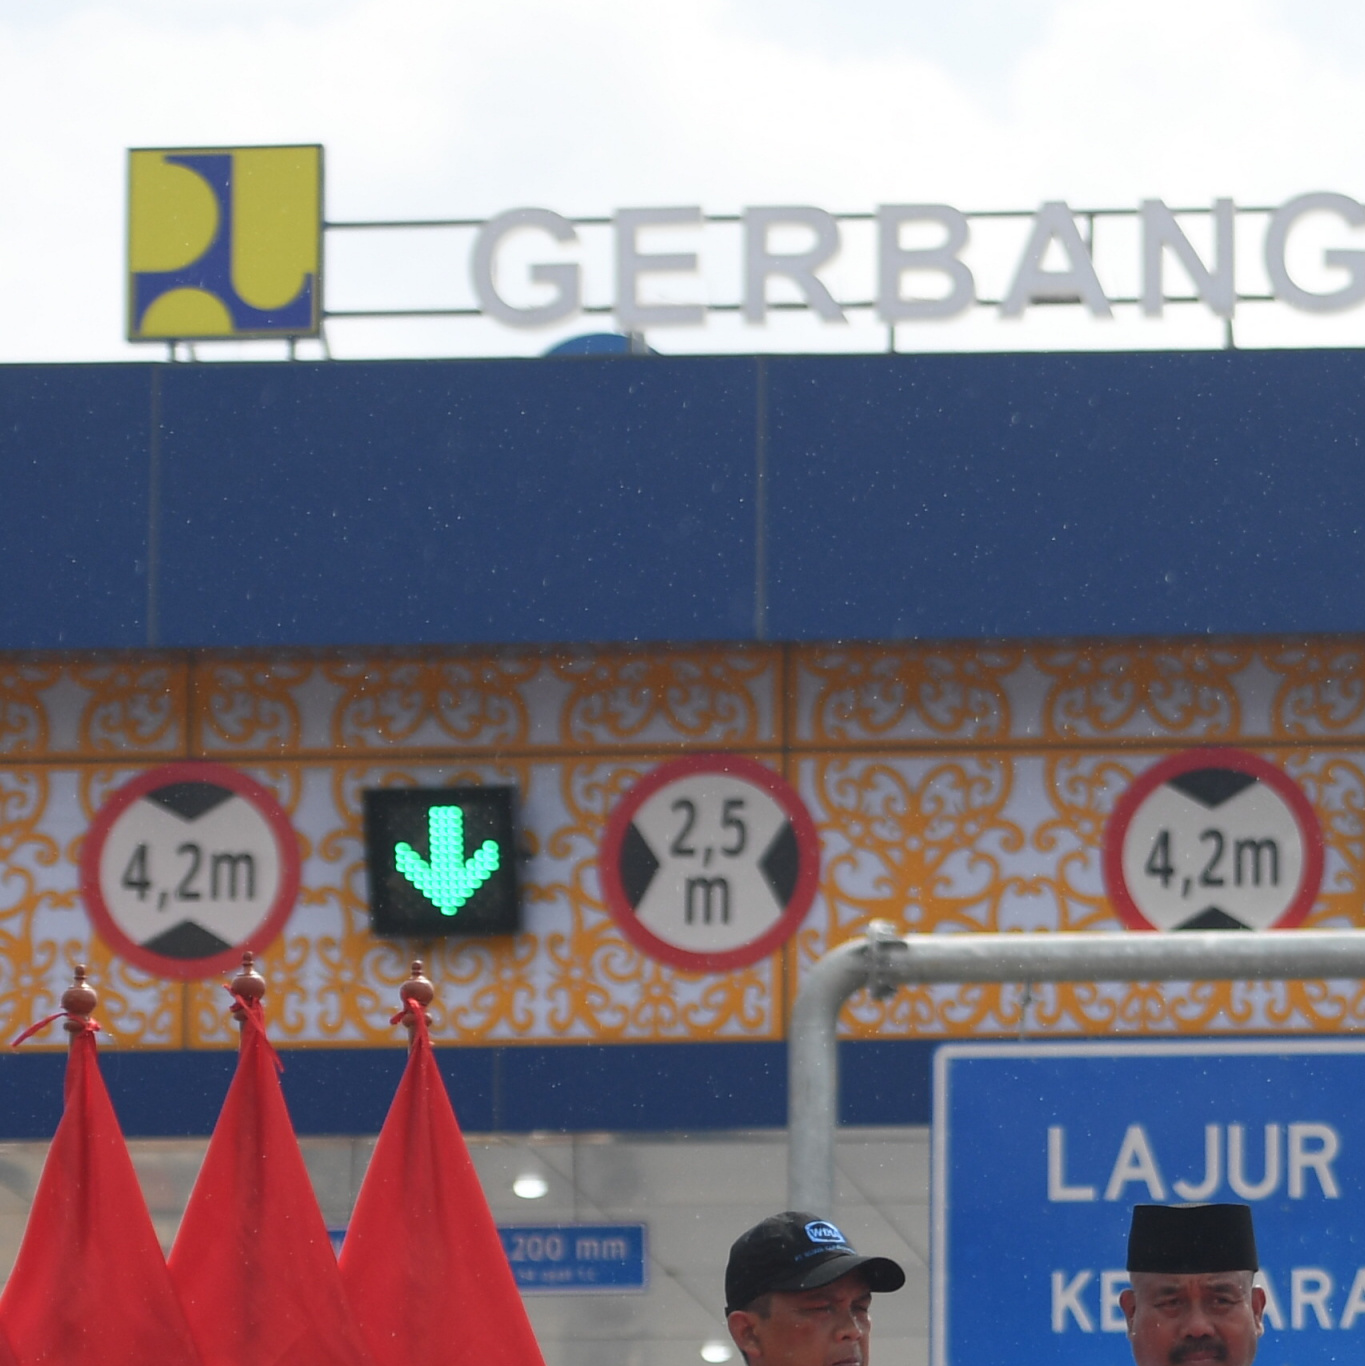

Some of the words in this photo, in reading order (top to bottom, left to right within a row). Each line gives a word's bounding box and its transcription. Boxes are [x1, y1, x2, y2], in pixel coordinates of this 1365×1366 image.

[669, 799, 748, 864] 2,5
[1144, 829, 1281, 897] 4,2m
[122, 842, 256, 910] 4,2m
[686, 876, 731, 925] m
[1046, 1121, 1340, 1201] LAJUR
